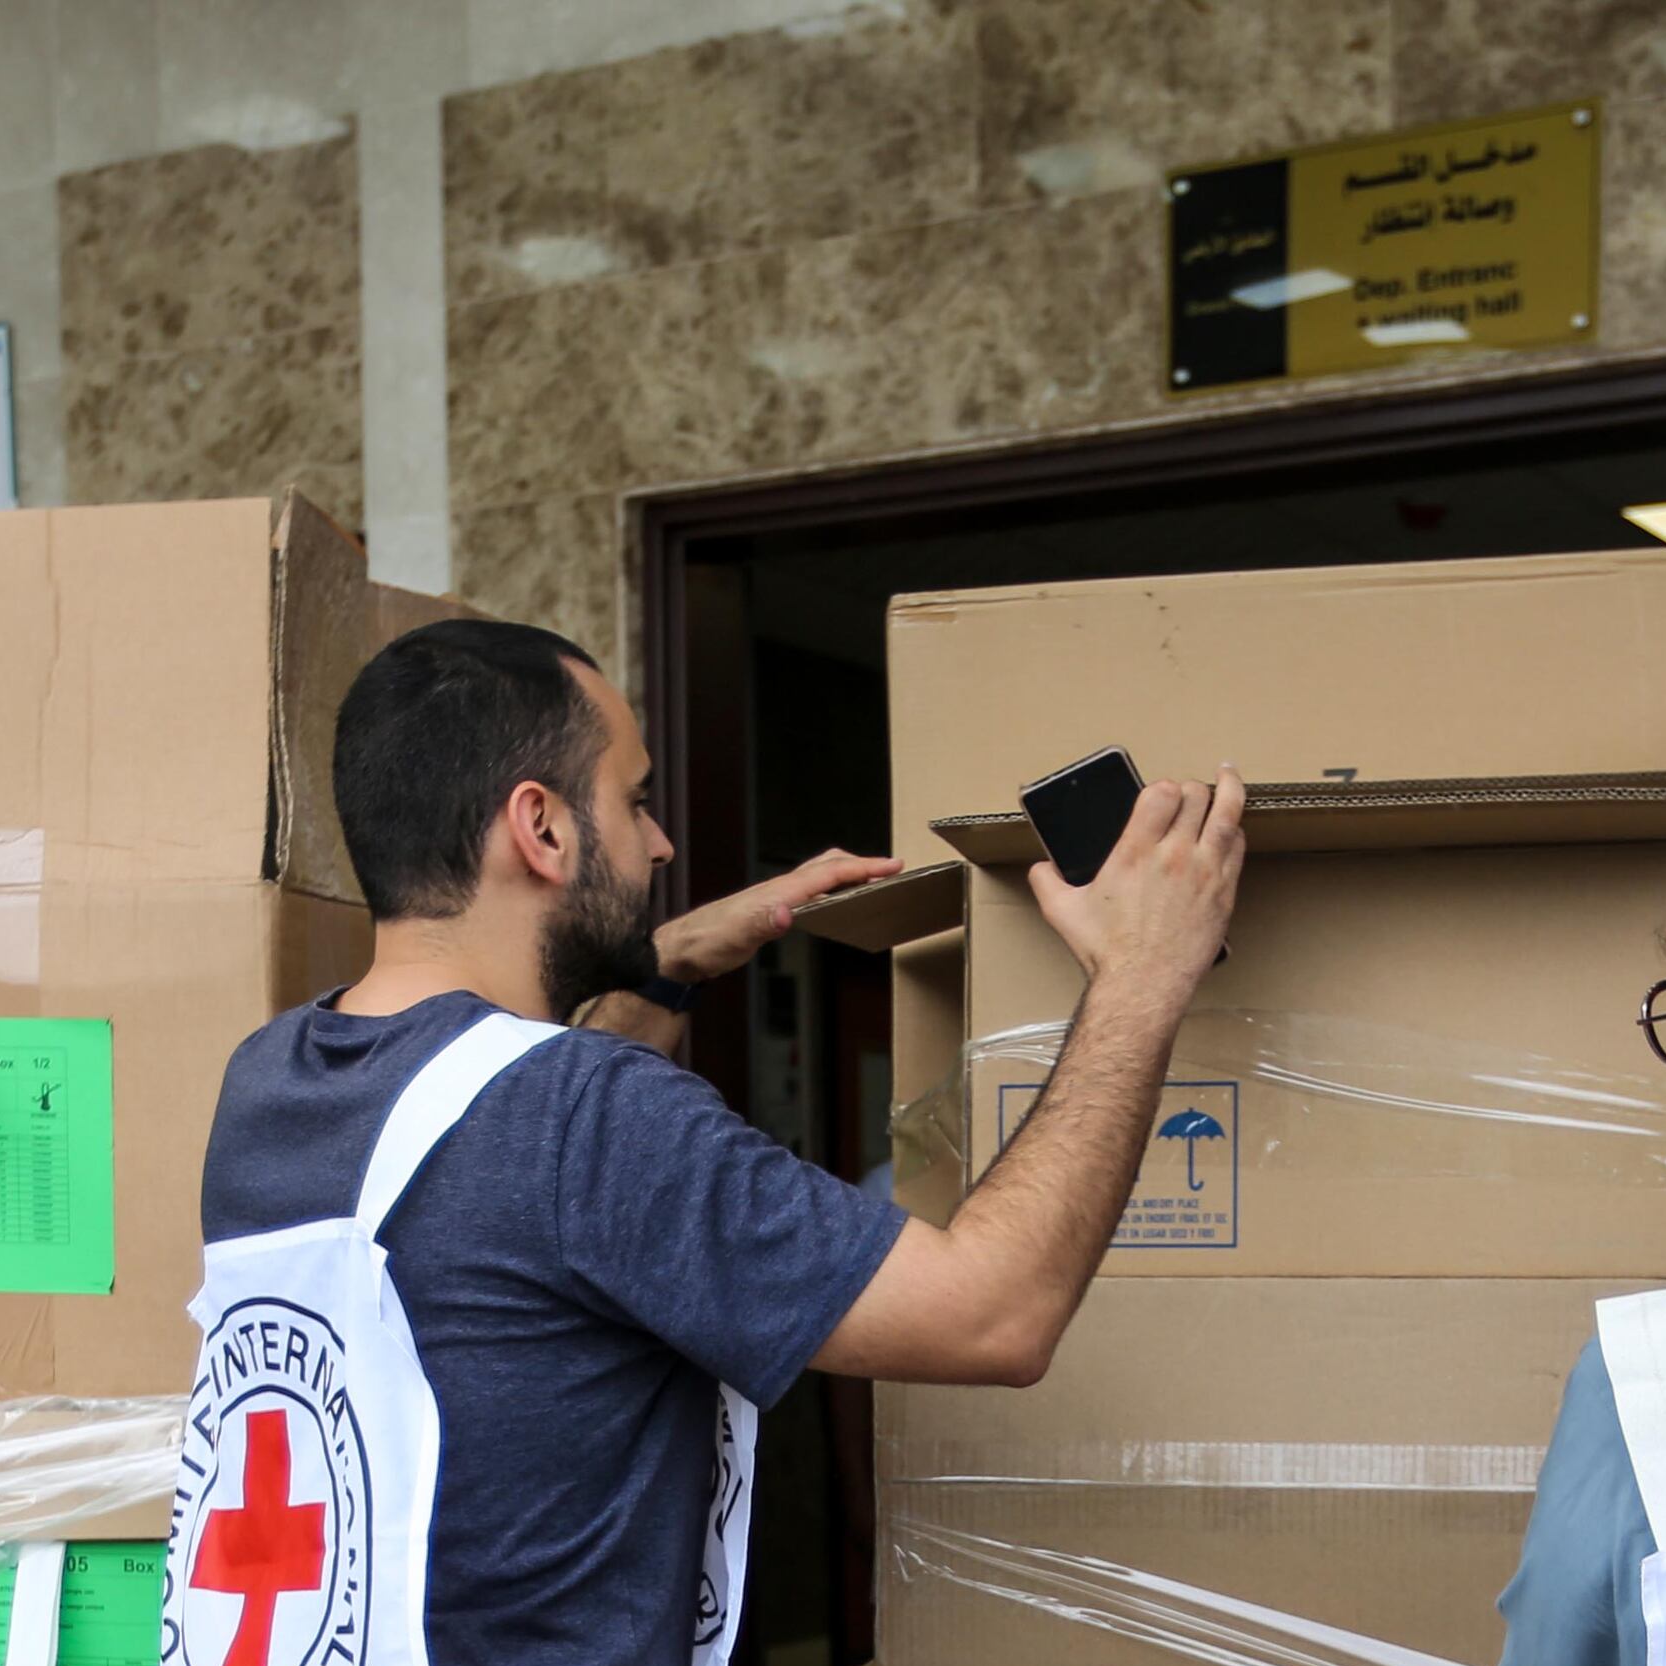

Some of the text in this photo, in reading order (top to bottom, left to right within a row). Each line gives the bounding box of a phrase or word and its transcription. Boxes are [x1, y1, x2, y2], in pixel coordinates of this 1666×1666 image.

[1475, 288, 1523, 317] hall
[33, 1058, 50, 1069] 1/2
[123, 1558, 155, 1574] Box
